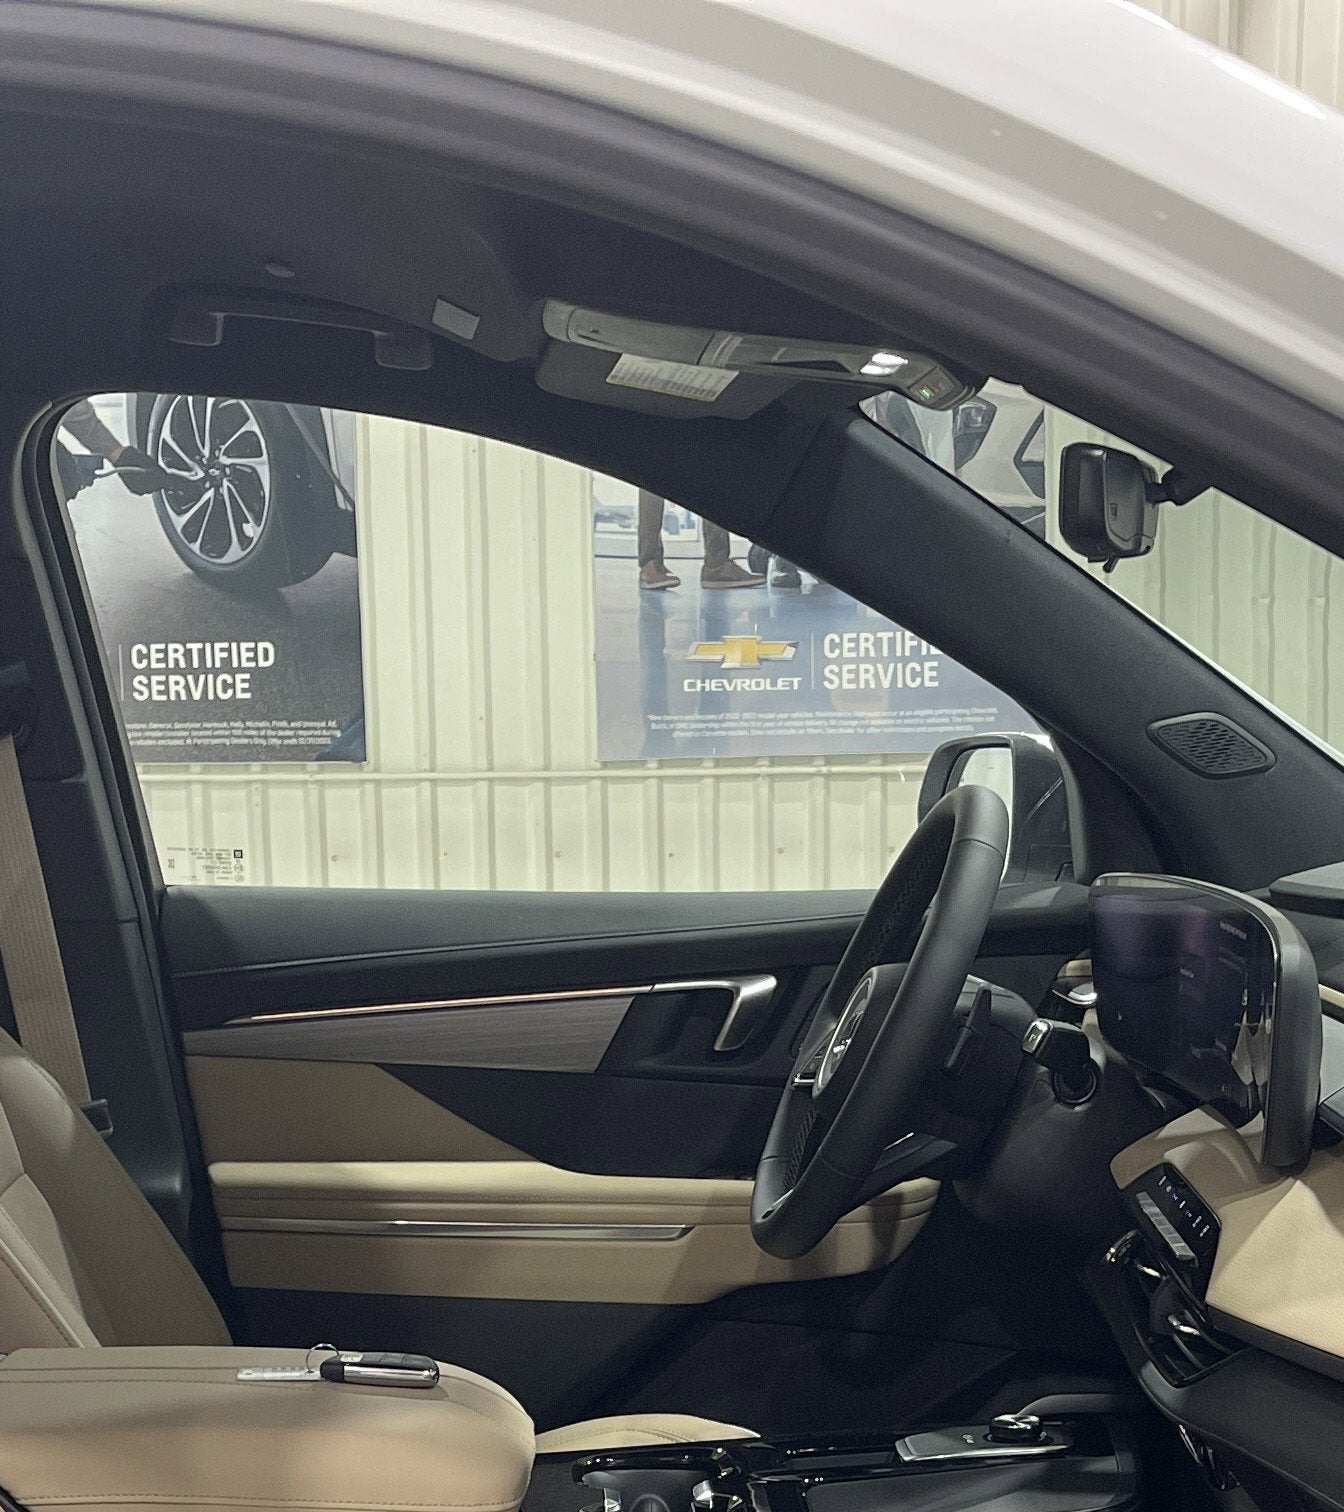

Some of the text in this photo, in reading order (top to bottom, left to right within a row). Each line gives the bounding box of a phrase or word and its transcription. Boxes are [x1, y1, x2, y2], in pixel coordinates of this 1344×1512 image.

[130, 641, 275, 670] CERTIFIED
[823, 631, 944, 659] CERTIFI
[132, 673, 252, 701] SERVICE
[683, 677, 802, 692] CHEVROLET
[822, 661, 940, 690] SERVICE
